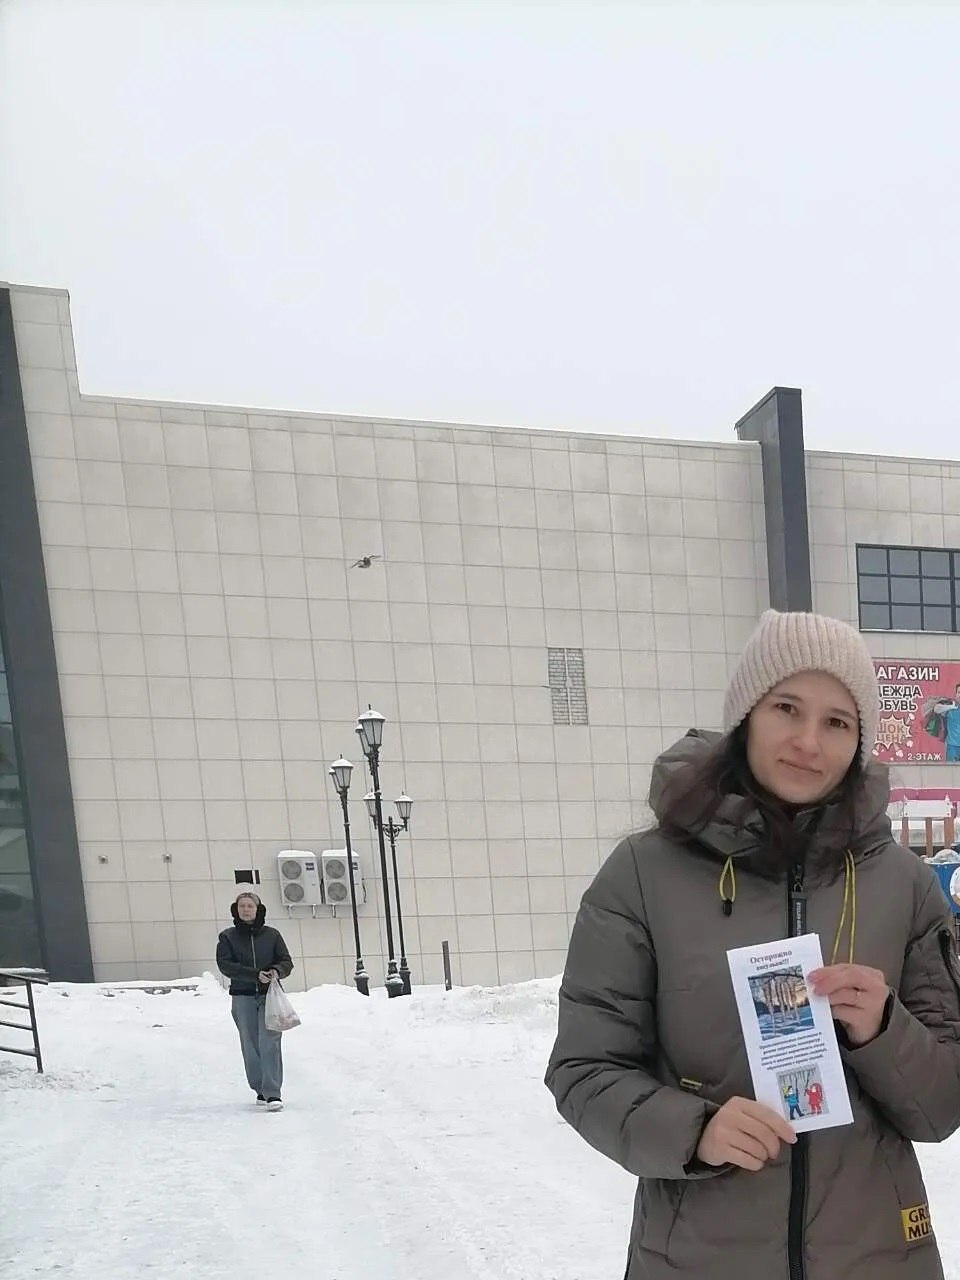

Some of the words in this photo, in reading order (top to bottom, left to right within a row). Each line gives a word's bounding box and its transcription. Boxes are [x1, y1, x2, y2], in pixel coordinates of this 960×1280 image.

[875, 665, 940, 681] АГАЗИН
[907, 752, 942, 761] 2-ЭТАЖ
[908, 1206, 929, 1223] GR
[908, 1222, 931, 1240] MU
